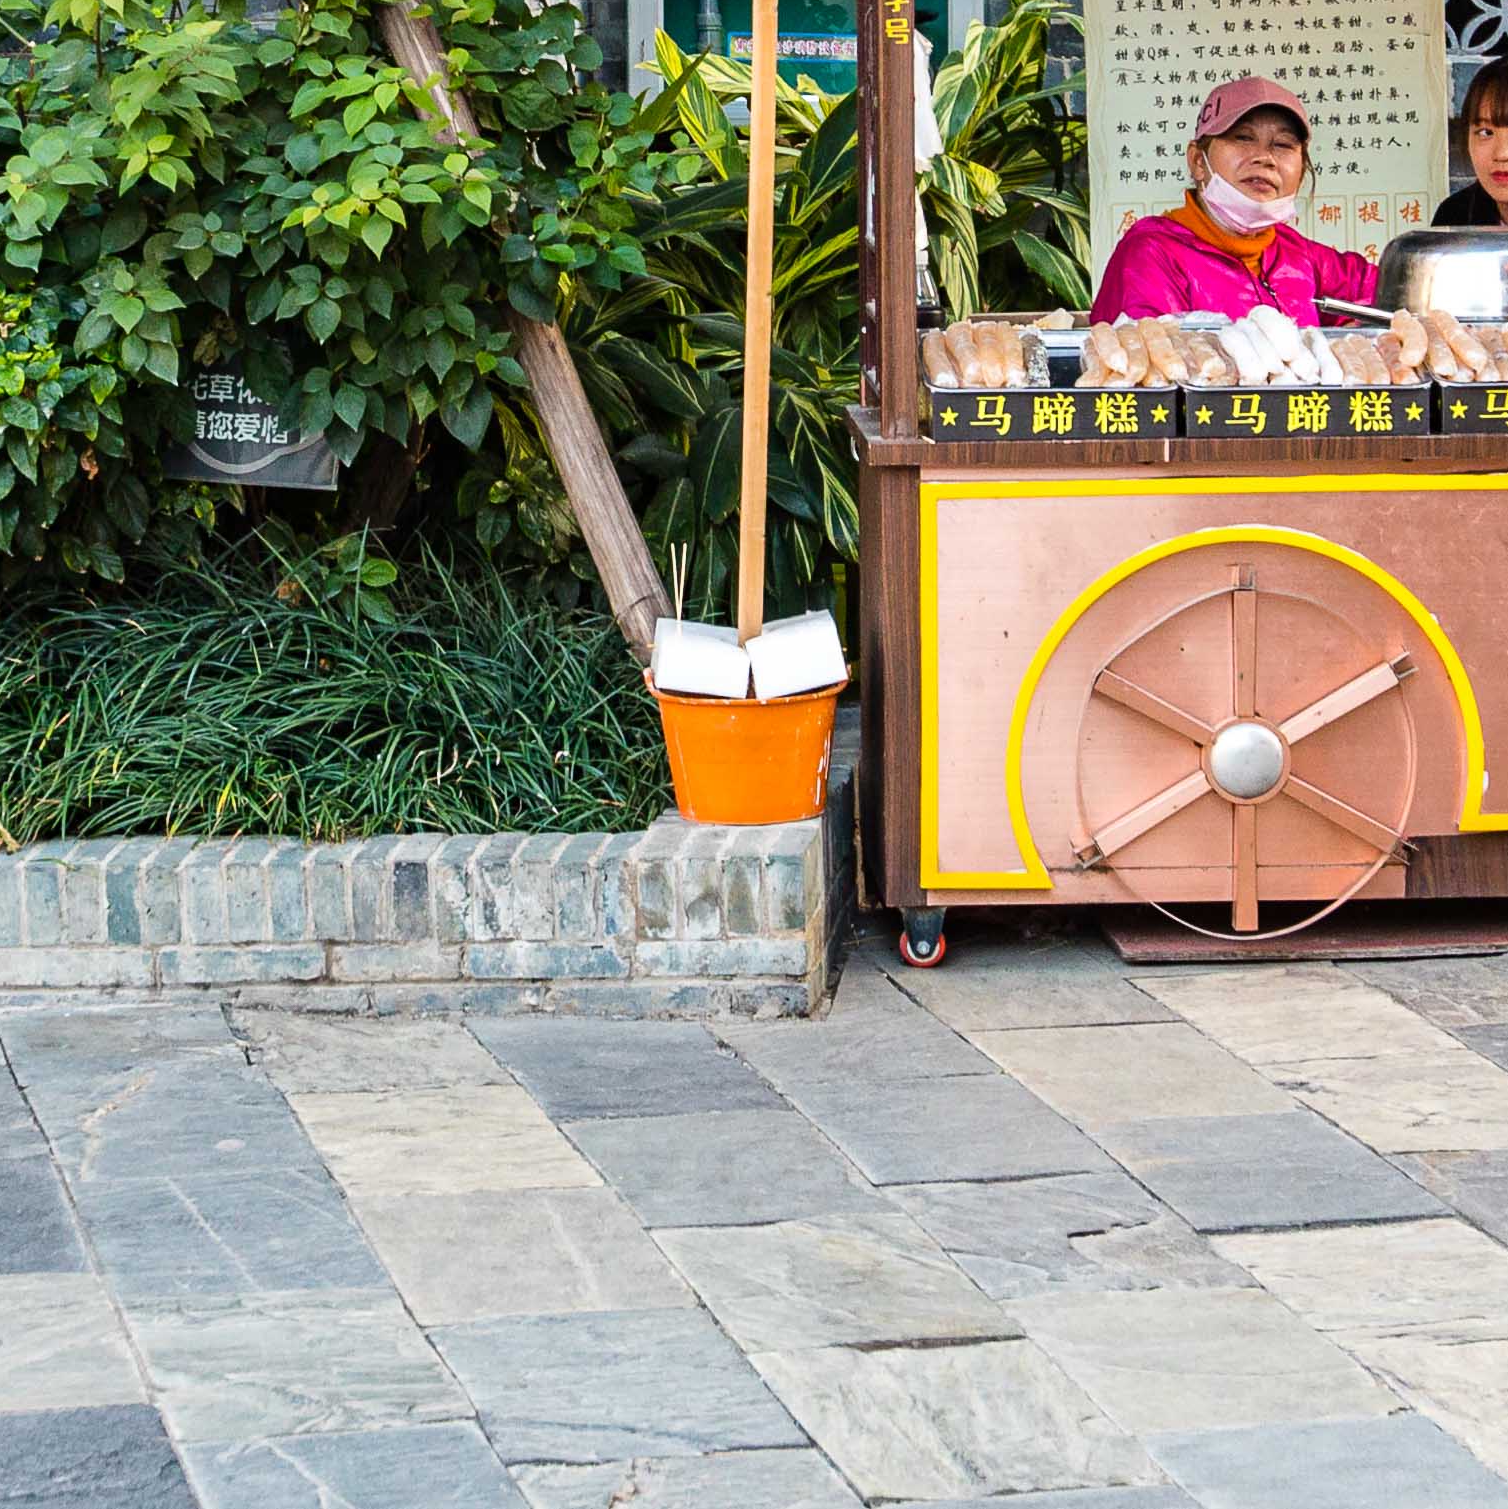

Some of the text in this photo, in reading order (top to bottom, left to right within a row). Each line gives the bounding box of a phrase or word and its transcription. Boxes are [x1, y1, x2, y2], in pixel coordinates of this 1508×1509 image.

[970, 393, 1140, 436] 马蹄糕
[1224, 390, 1394, 434] 马蹄糕
